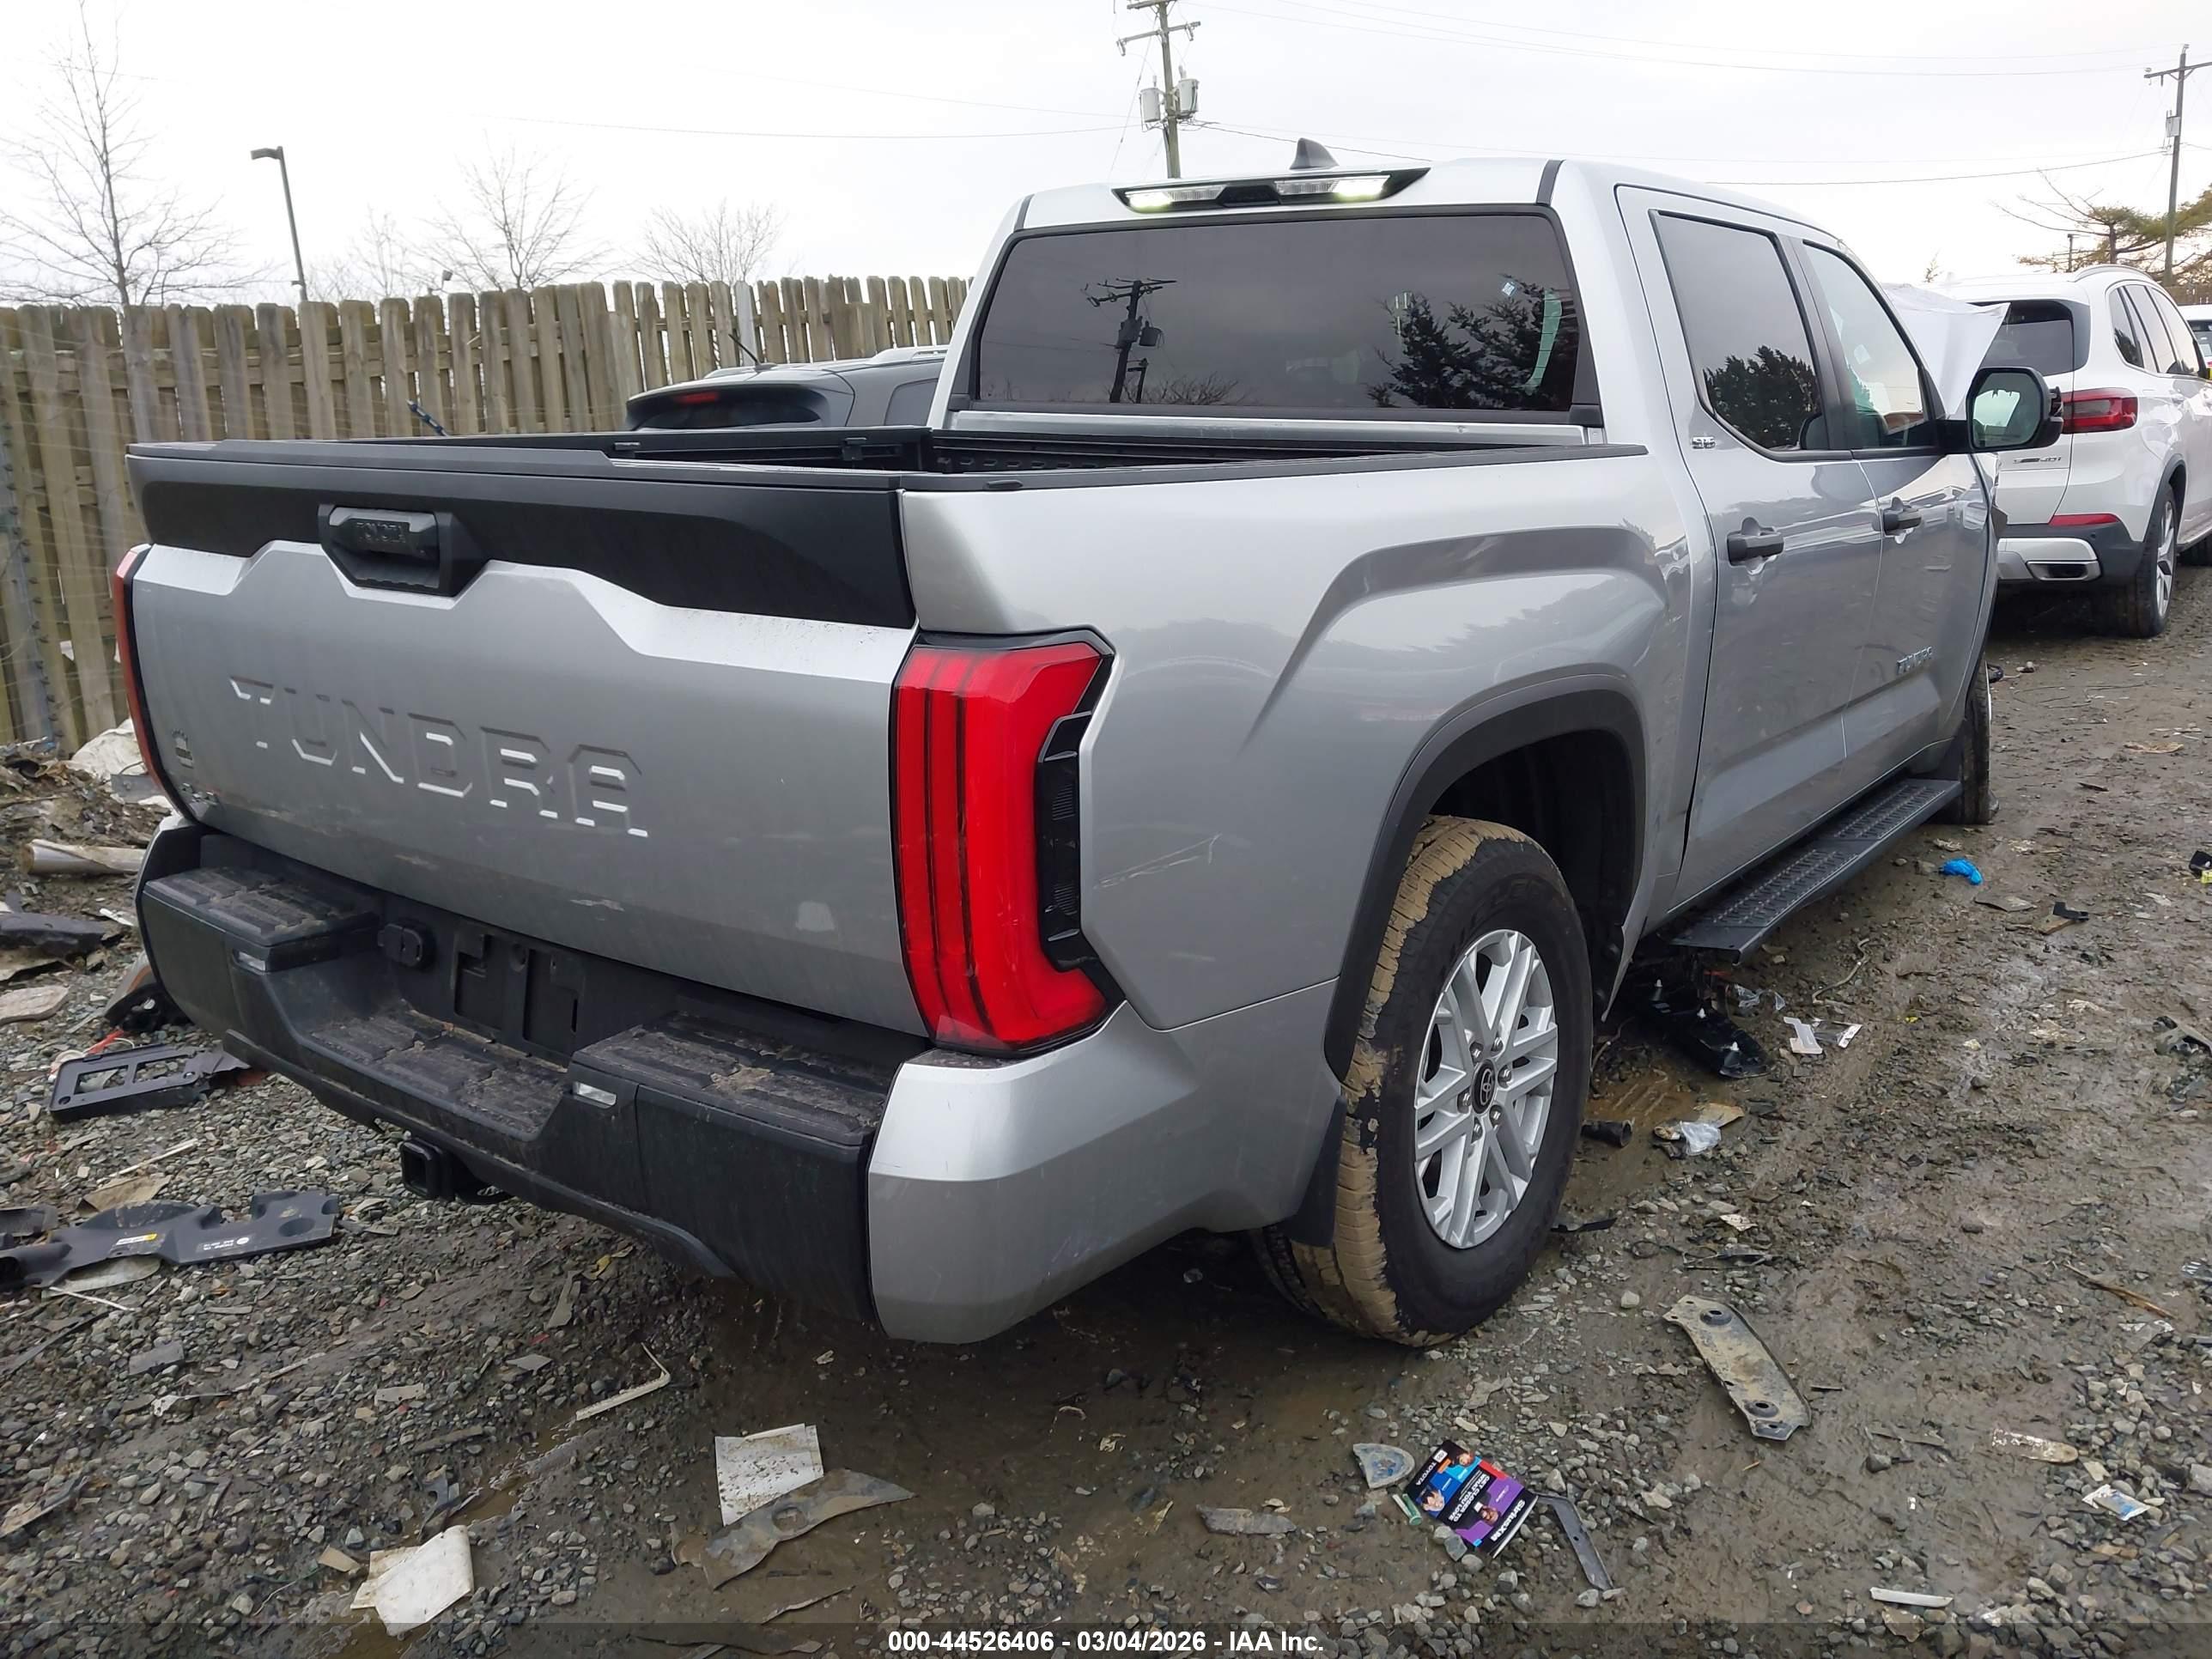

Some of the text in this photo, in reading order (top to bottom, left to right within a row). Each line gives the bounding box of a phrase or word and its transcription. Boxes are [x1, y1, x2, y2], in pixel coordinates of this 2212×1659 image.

[228, 676, 648, 838] TUNDRA
[1416, 1462, 1437, 1486] TOYOTA
[1471, 1472, 1486, 1491] WHAT
[1478, 1474, 1491, 1489] GET
[1460, 1491, 1473, 1504] YOU
[1460, 1488, 1481, 1513] CLOSER
[1449, 1503, 1463, 1522] LOVE
[1490, 1499, 1526, 1541] SiriusXM
